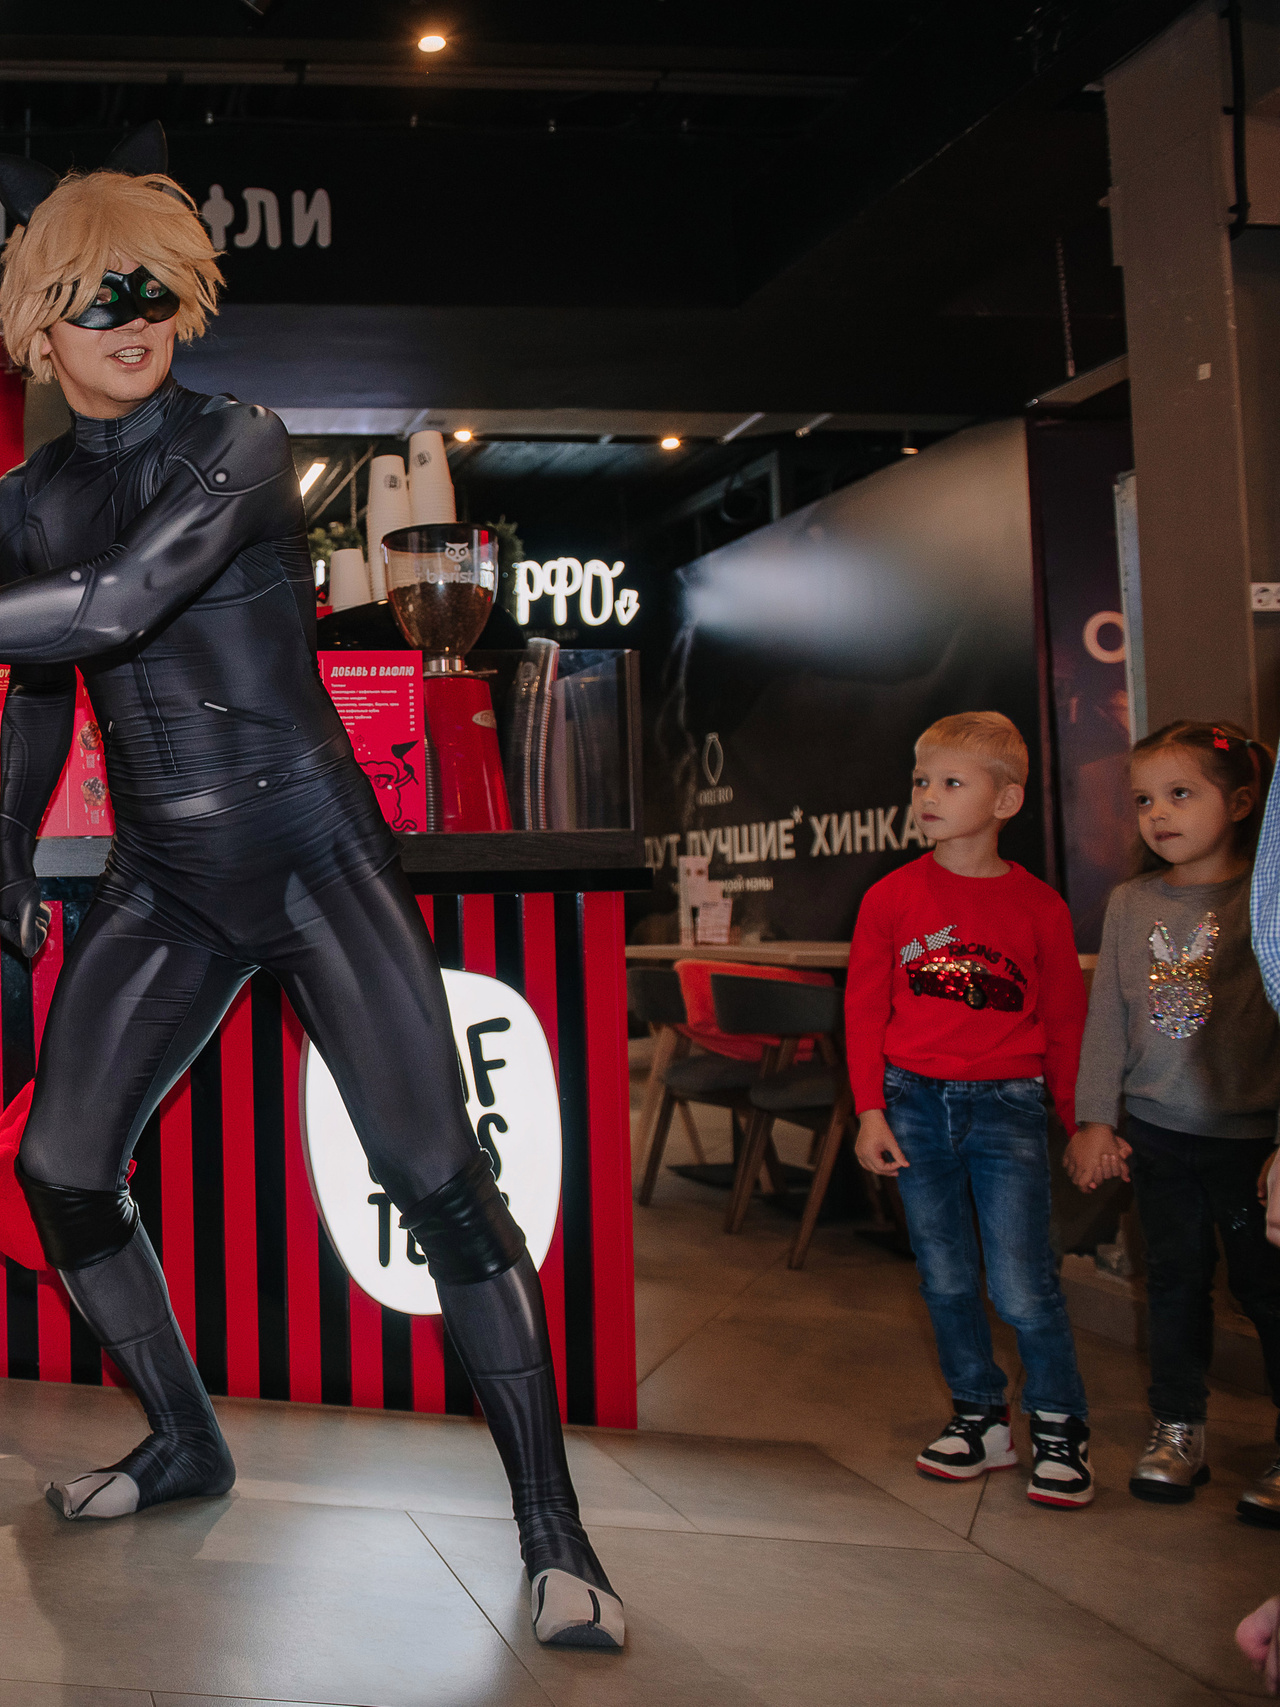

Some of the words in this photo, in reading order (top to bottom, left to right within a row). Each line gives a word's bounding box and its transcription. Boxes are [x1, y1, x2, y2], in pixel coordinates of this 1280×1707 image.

[330, 666, 368, 677] ДОБАВЬ
[370, 666, 377, 676] В
[379, 666, 414, 676] ВАФЛЮ
[809, 805, 937, 858] ХИНКА
